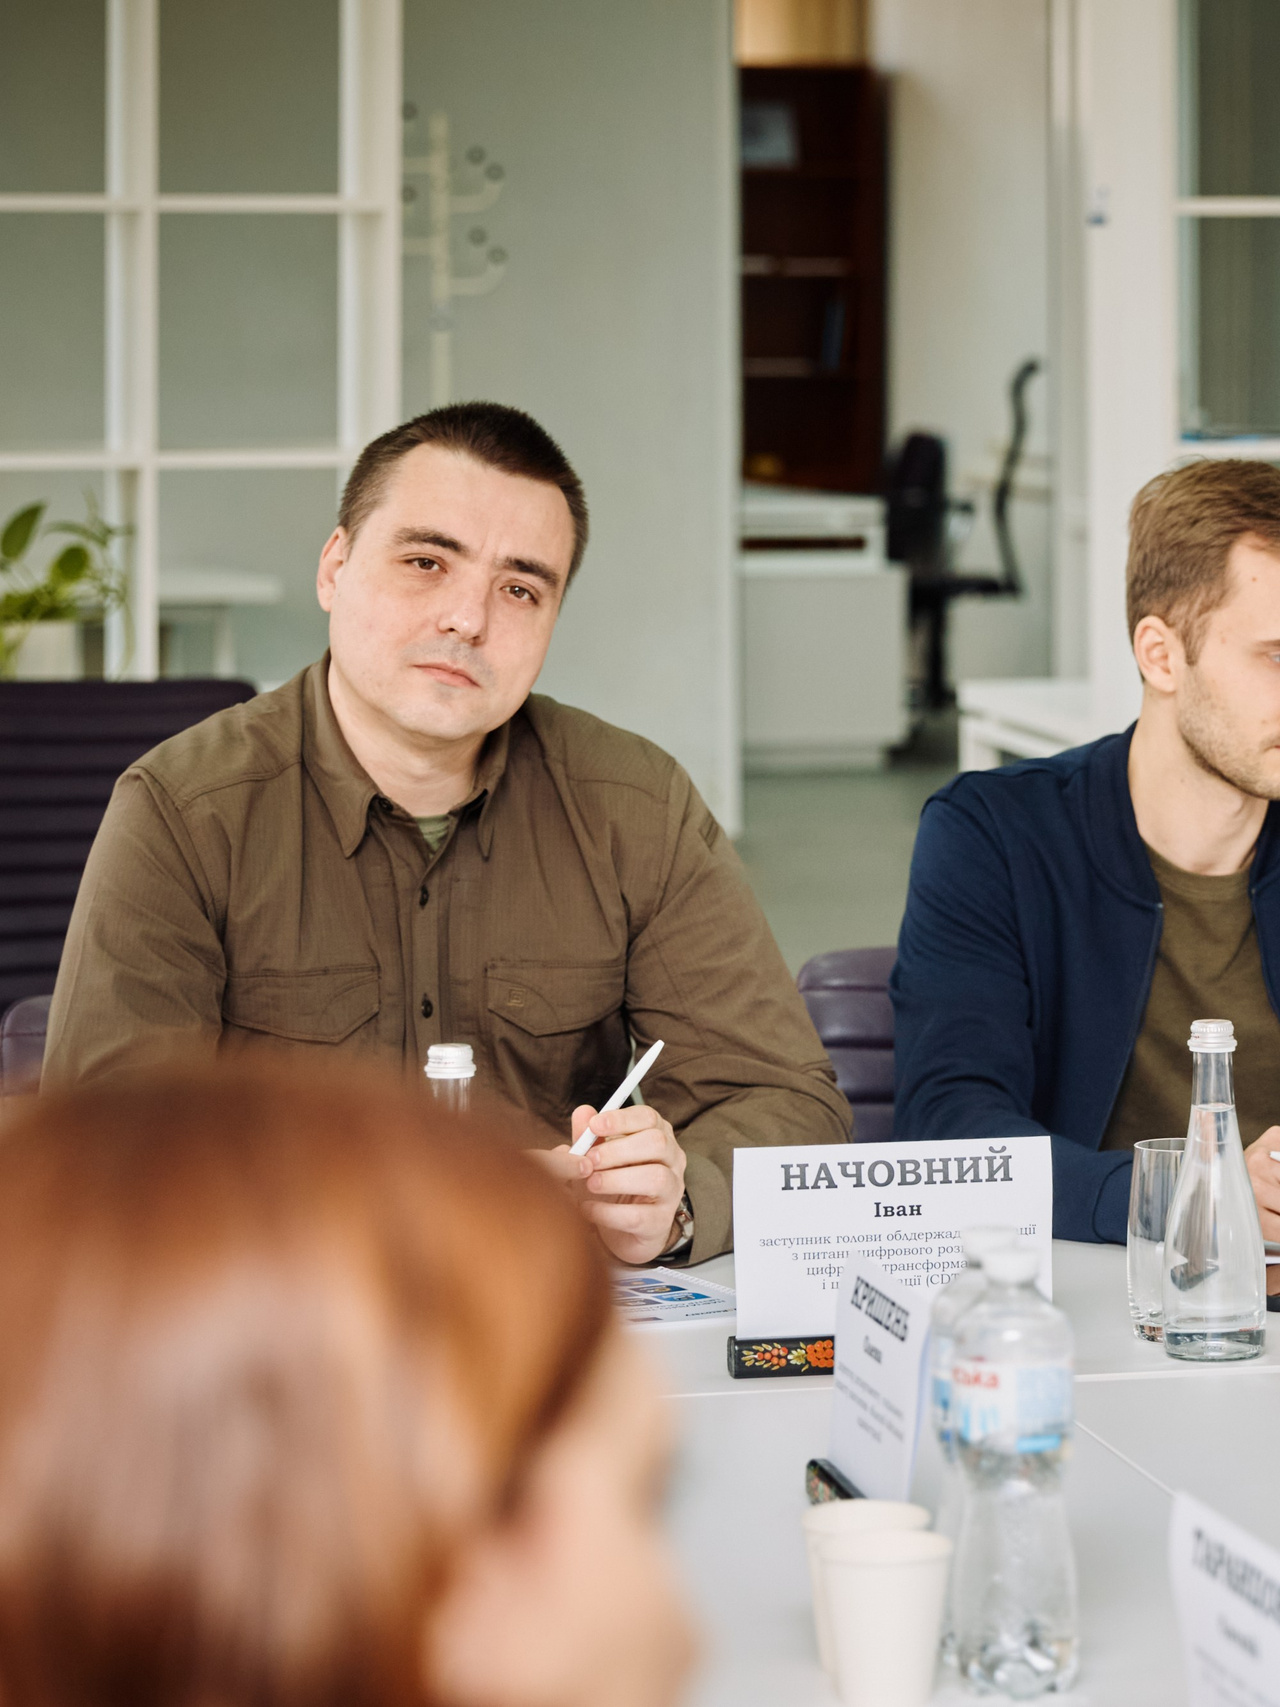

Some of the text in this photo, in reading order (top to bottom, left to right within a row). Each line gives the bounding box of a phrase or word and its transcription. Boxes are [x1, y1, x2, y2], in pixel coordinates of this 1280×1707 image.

[780, 1145, 1013, 1191] НАЧОВНИЙ
[873, 1201, 923, 1218] Іван
[759, 1235, 832, 1249] заступник
[836, 1232, 882, 1244] голови
[882, 1259, 968, 1274] трансформа
